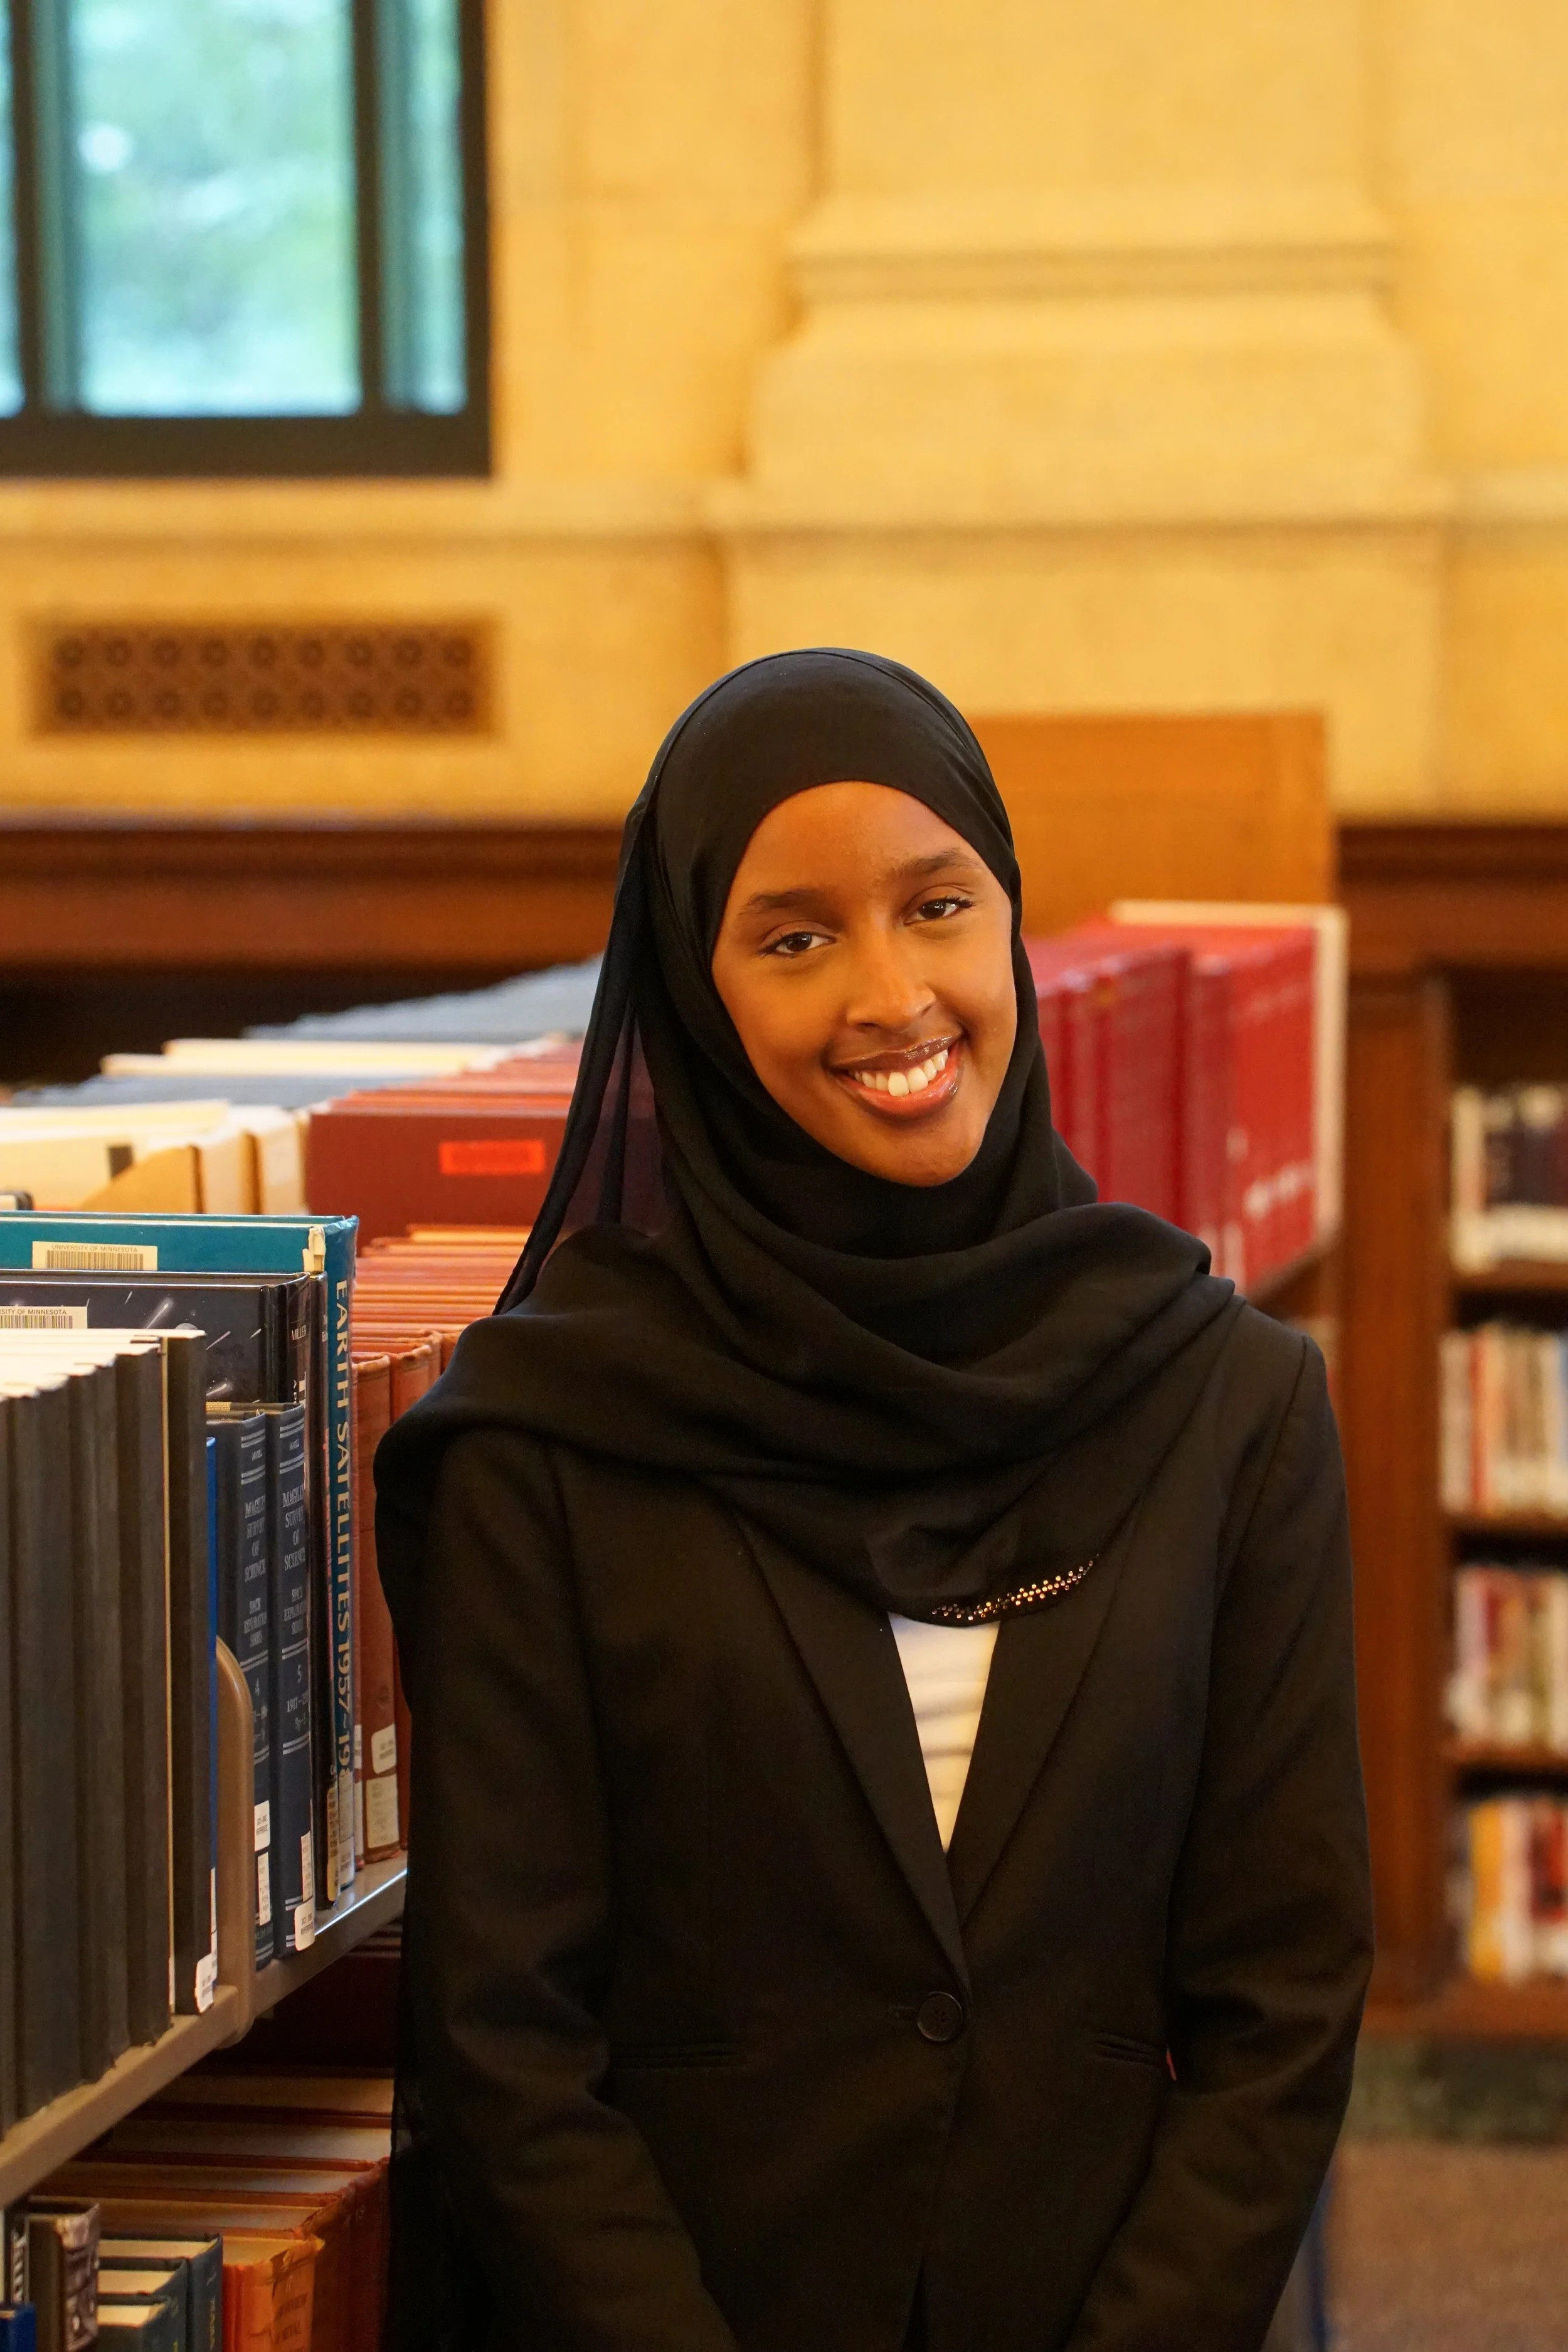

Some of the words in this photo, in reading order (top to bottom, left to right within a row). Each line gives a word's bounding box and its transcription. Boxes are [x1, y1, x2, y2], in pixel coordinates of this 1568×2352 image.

[291, 1325, 307, 1341] MILLER
[337, 1280, 349, 1407] EARTH
[337, 1421, 350, 1632] SATELLITES
[297, 1663, 302, 1683] 5
[255, 1678, 260, 1696] 4
